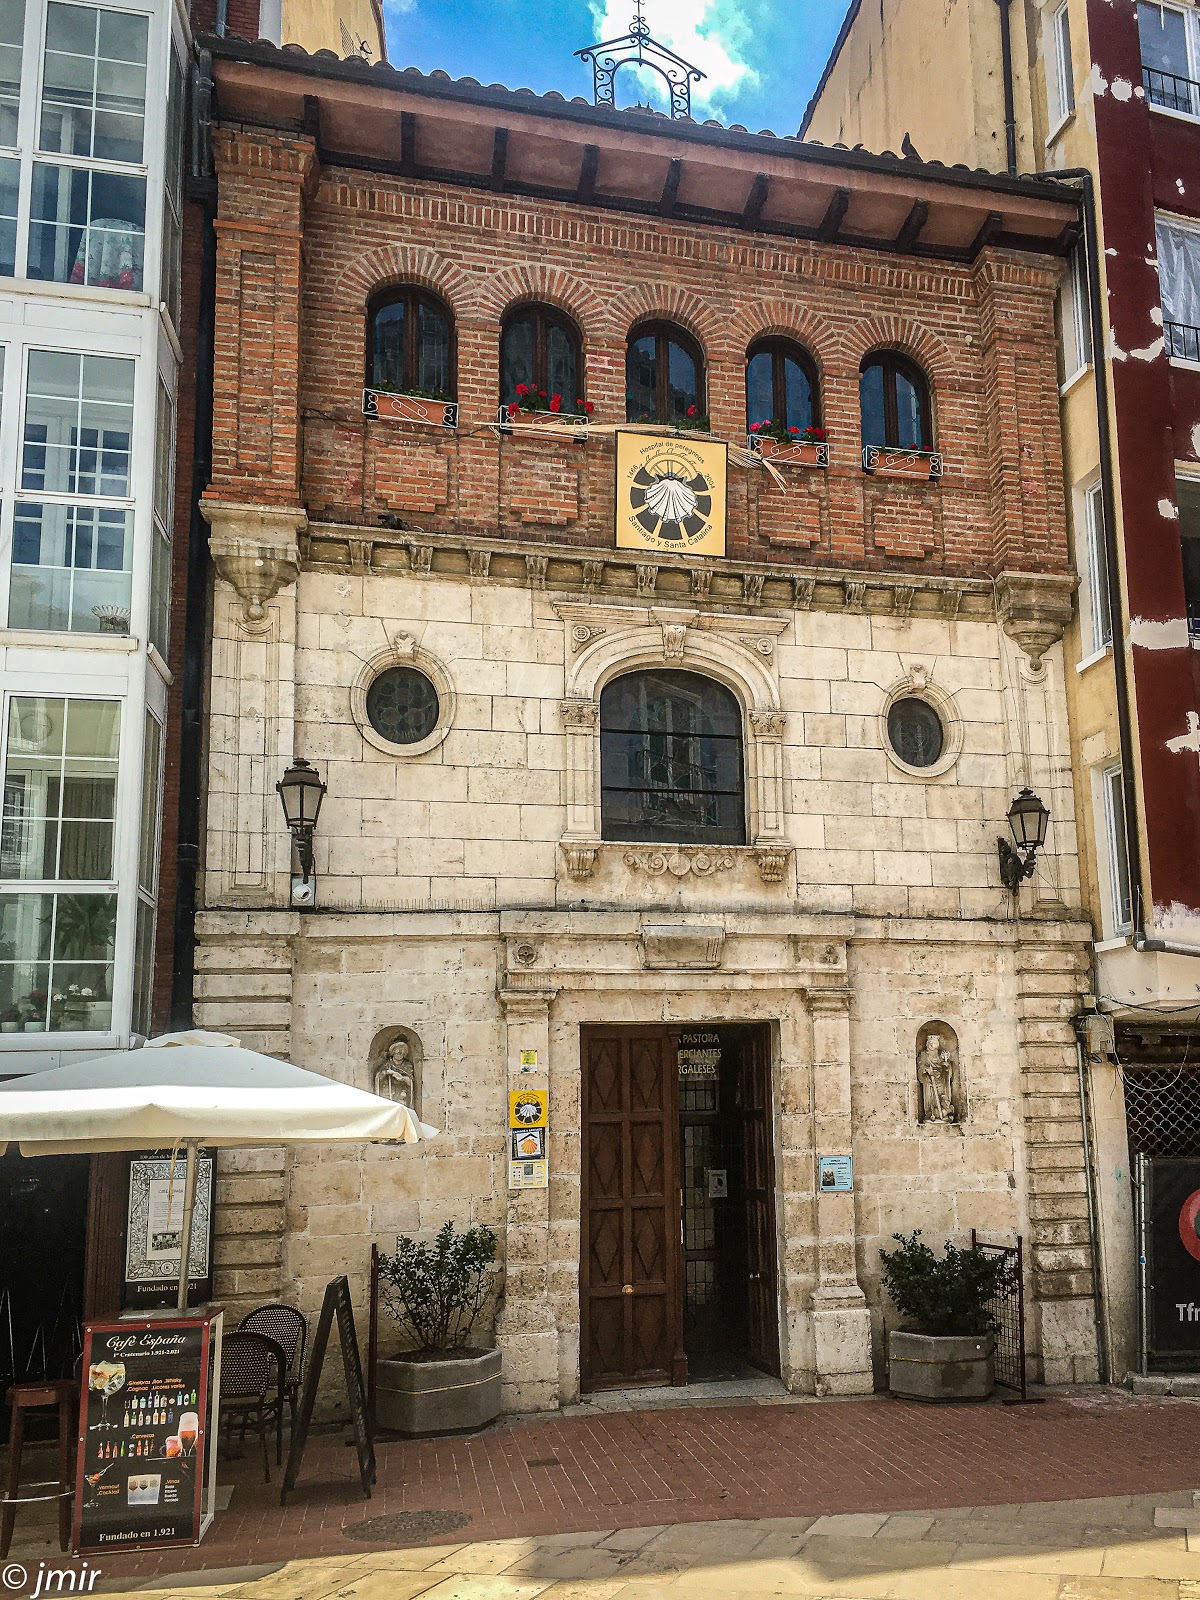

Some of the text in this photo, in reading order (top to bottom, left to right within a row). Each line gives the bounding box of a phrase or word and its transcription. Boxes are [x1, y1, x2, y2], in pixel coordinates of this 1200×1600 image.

[639, 441, 664, 455] Hospital
[674, 443, 705, 465] peregrinos
[628, 515, 656, 543] Santiago
[664, 541, 687, 549] Santa
[687, 524, 713, 546] Catalina
[682, 1033, 720, 1044] PASTORA
[678, 1048, 722, 1059] ERCIANTES
[137, 1284, 169, 1293] Fundado
[139, 1333, 187, 1350] España
[99, 1527, 176, 1542] Fundado en 1.921
